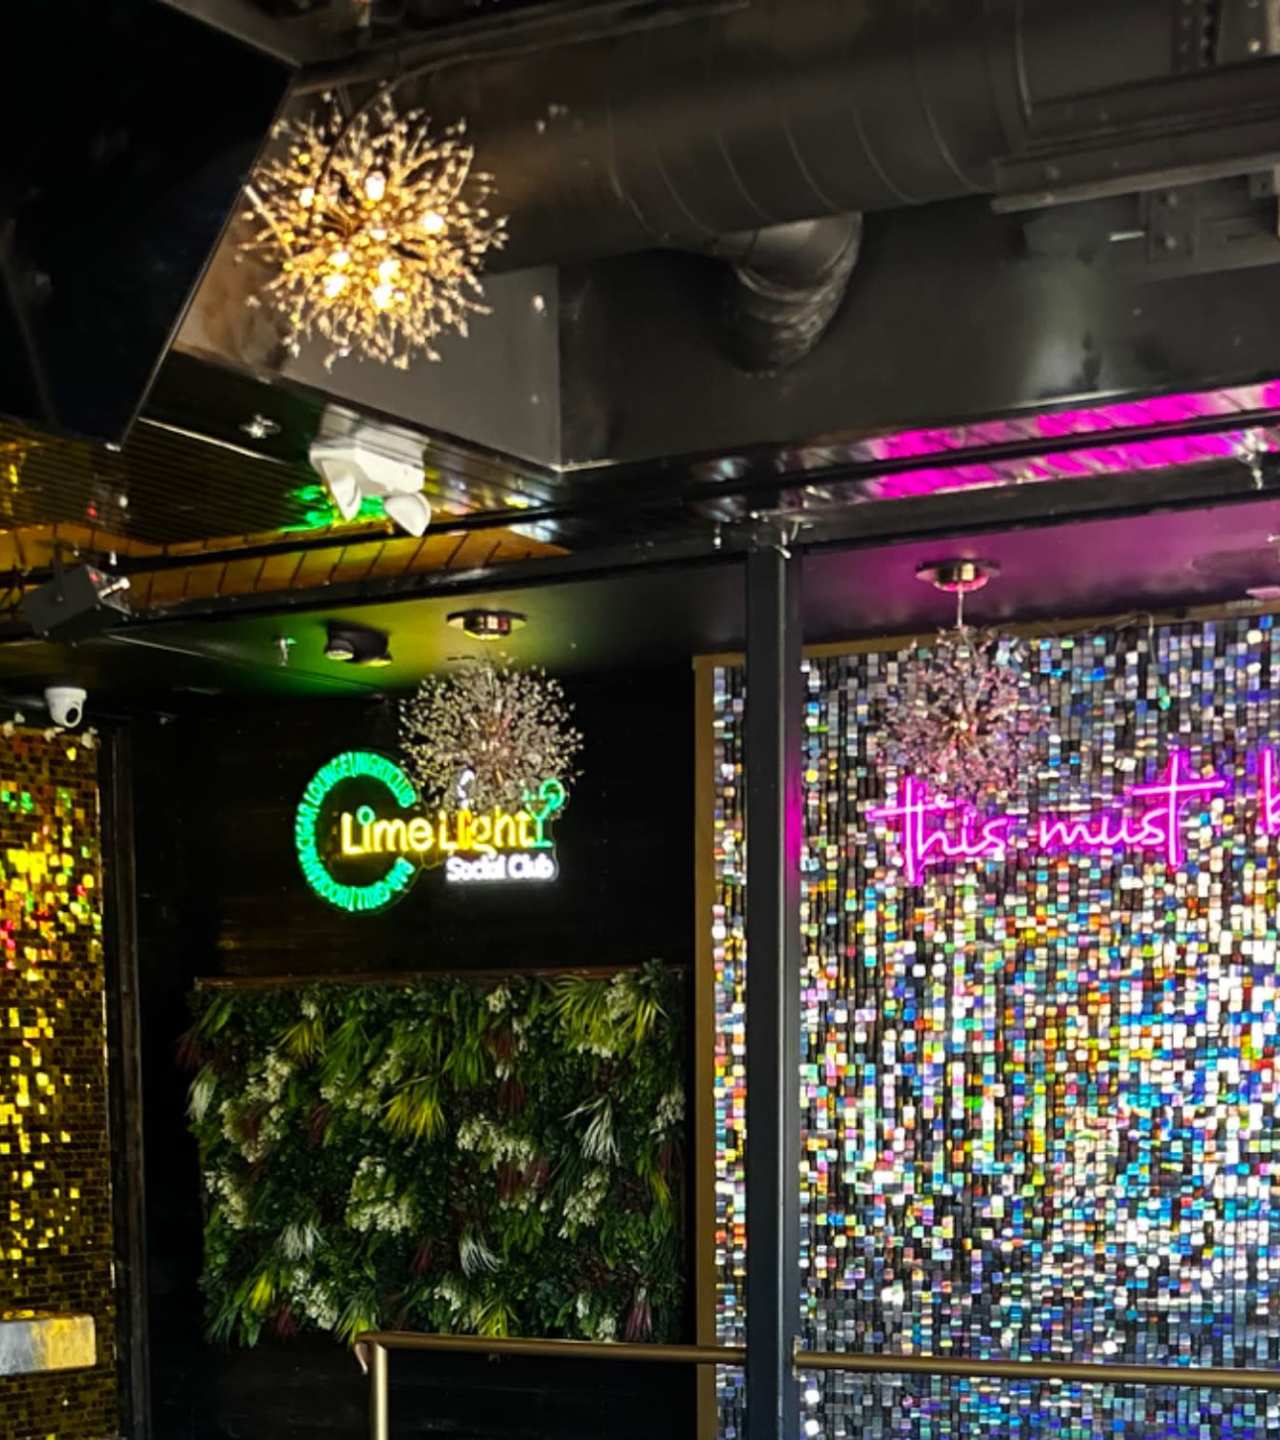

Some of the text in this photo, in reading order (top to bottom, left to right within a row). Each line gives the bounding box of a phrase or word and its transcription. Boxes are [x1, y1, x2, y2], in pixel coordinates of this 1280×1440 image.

[340, 805, 433, 856] Lime
[864, 774, 1012, 884] this
[1037, 747, 1227, 870] must
[445, 853, 556, 882] Social Club
